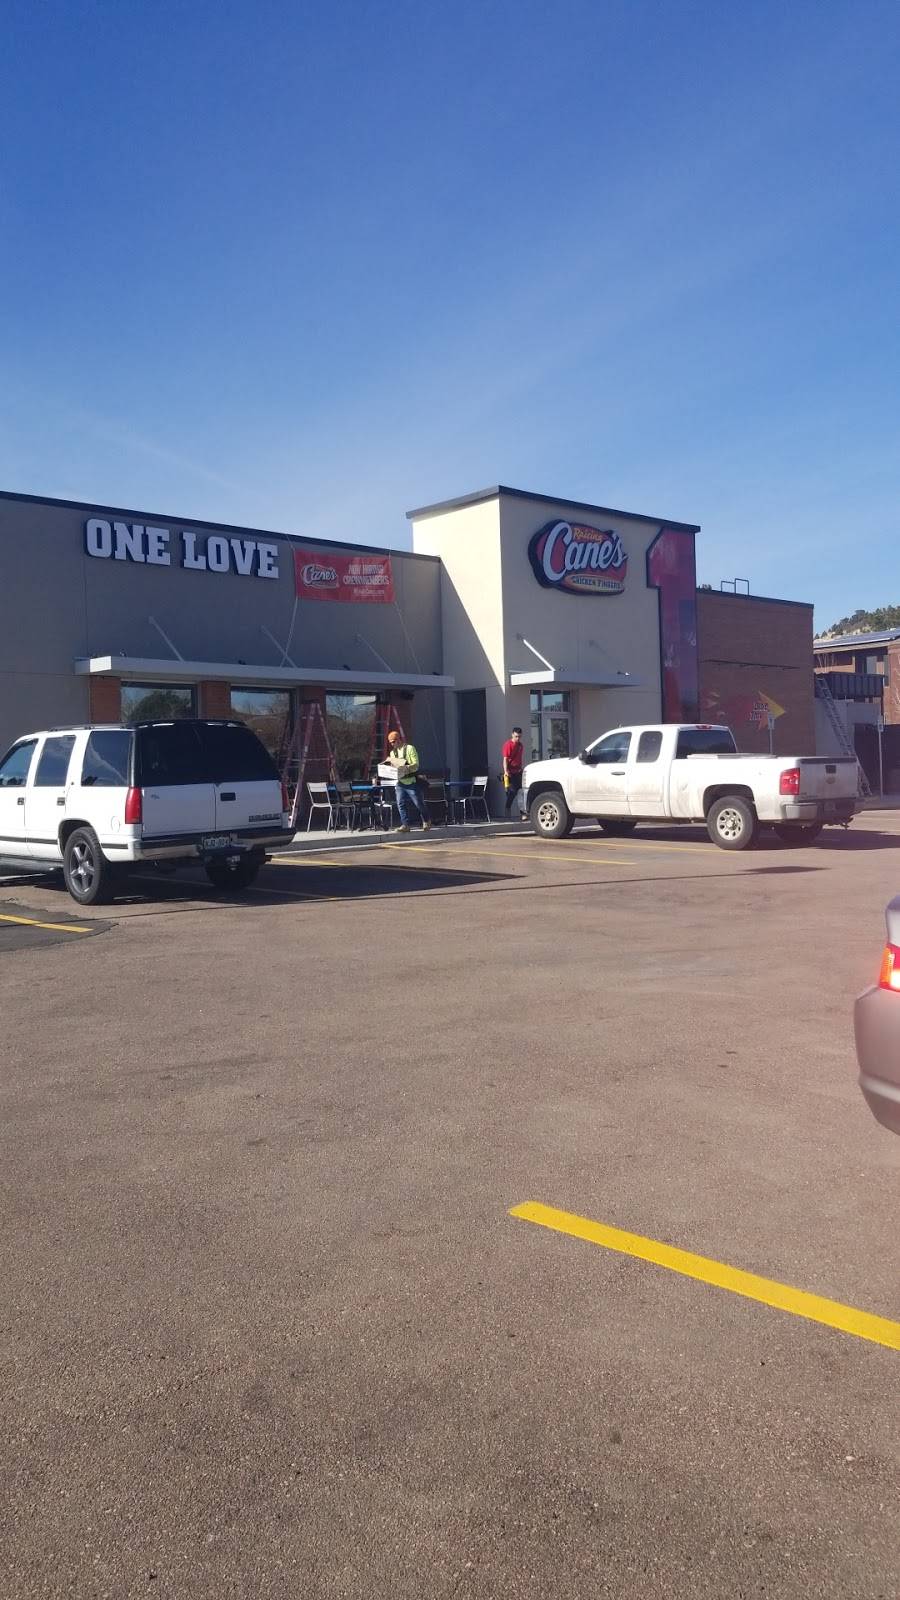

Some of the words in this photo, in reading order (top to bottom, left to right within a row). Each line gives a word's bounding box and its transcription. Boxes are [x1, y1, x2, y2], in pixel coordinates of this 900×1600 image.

[86, 518, 170, 566] ONE
[183, 531, 279, 579] LOVE
[543, 522, 628, 581] Cane's
[574, 527, 603, 544] Raising
[572, 576, 596, 586] CHICKEN
[598, 579, 624, 589] FINGERS
